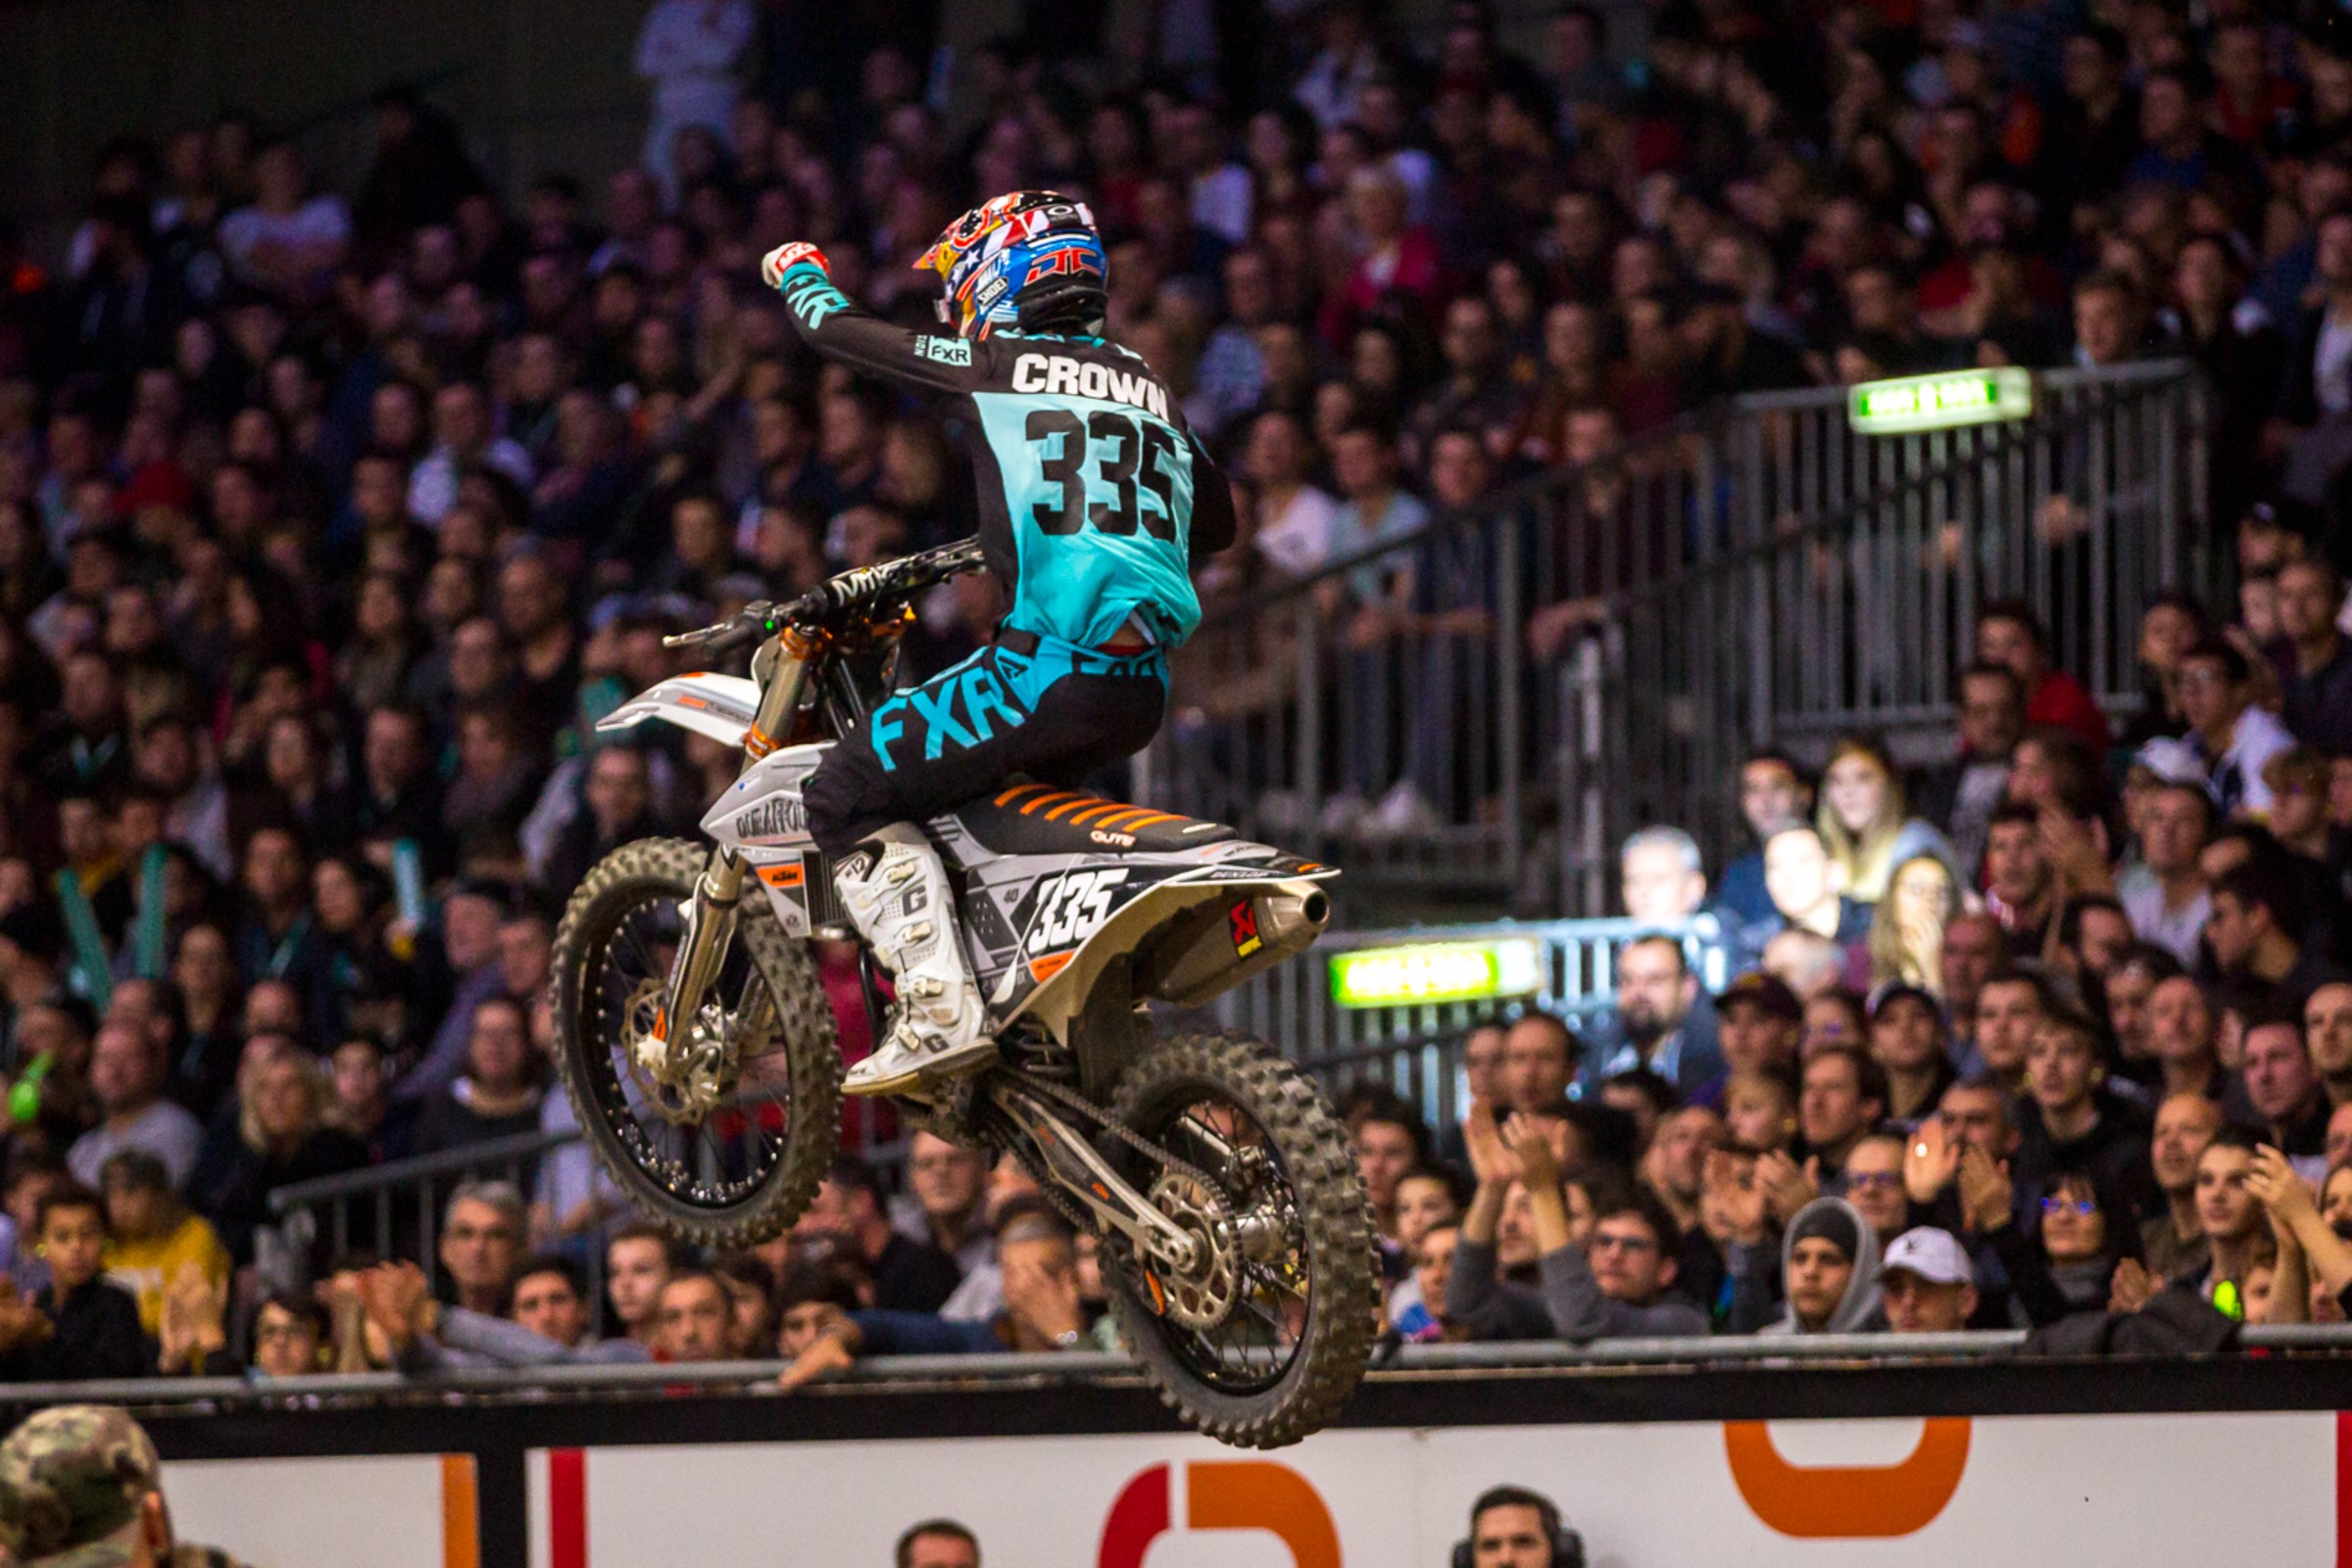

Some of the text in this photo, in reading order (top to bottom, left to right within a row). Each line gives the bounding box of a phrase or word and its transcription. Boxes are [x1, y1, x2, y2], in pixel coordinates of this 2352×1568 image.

[932, 345, 968, 363] FXR
[1011, 353, 1167, 423] CROWN
[1025, 409, 1175, 544] 335
[871, 664, 1026, 772] FXR
[1090, 830, 1138, 847] GUTS
[1028, 868, 1129, 955] 335
